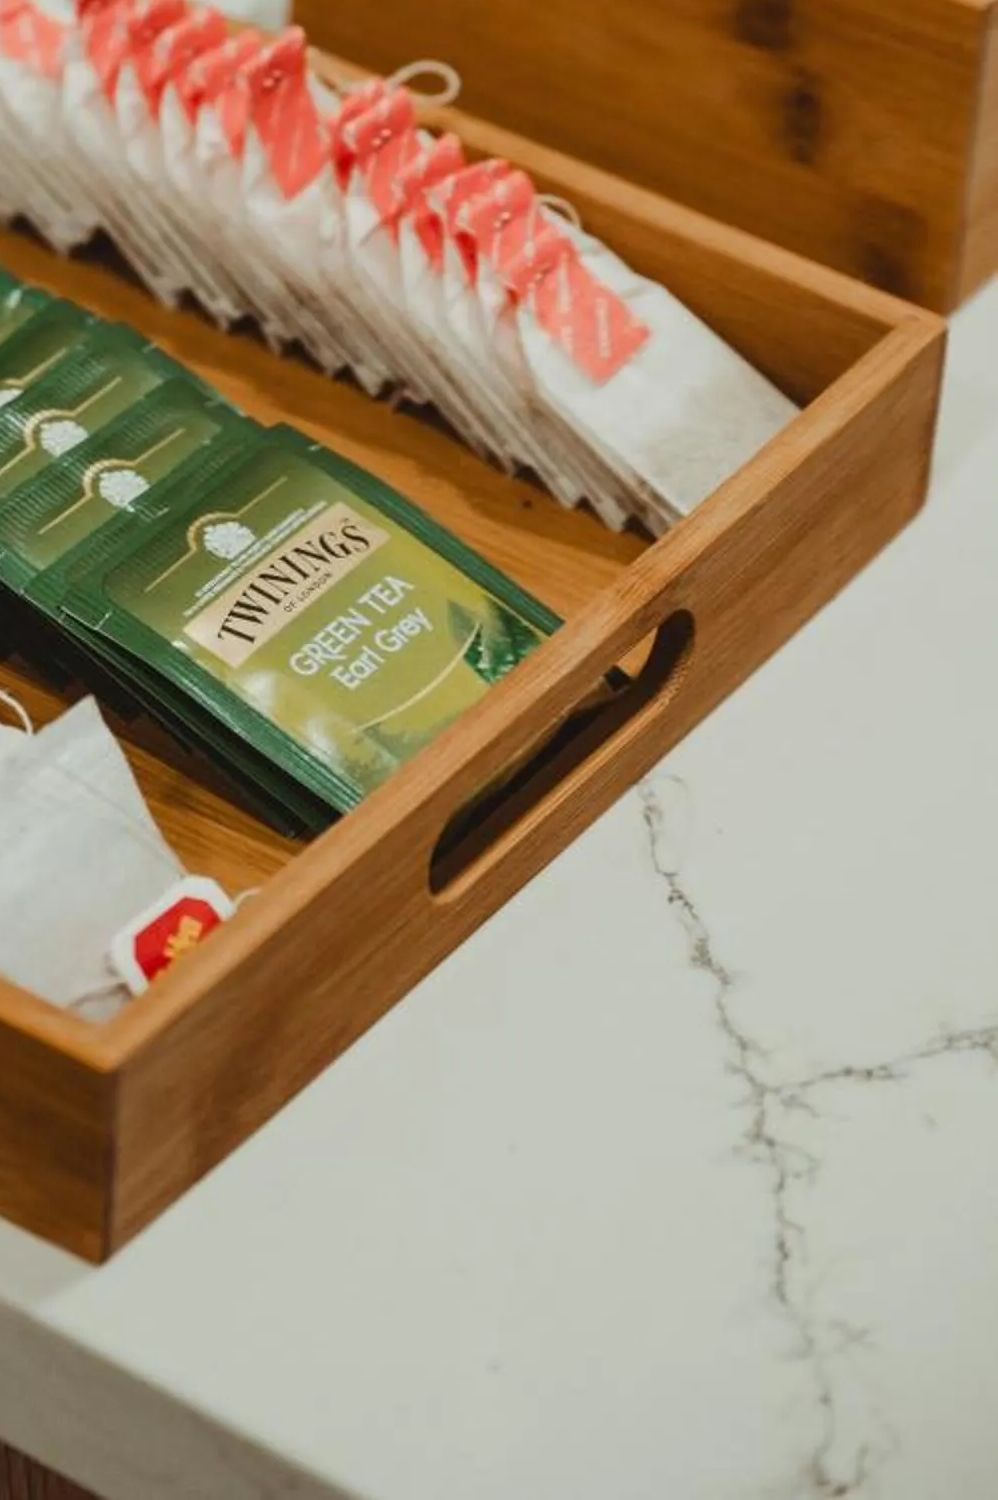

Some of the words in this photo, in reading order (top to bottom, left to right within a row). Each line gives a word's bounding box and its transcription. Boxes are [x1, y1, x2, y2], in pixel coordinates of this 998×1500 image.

[217, 524, 371, 644] TWININGS
[289, 607, 373, 676] GREEN
[358, 575, 416, 614] TEA
[330, 645, 386, 690] Earl
[374, 607, 434, 653] Grey
